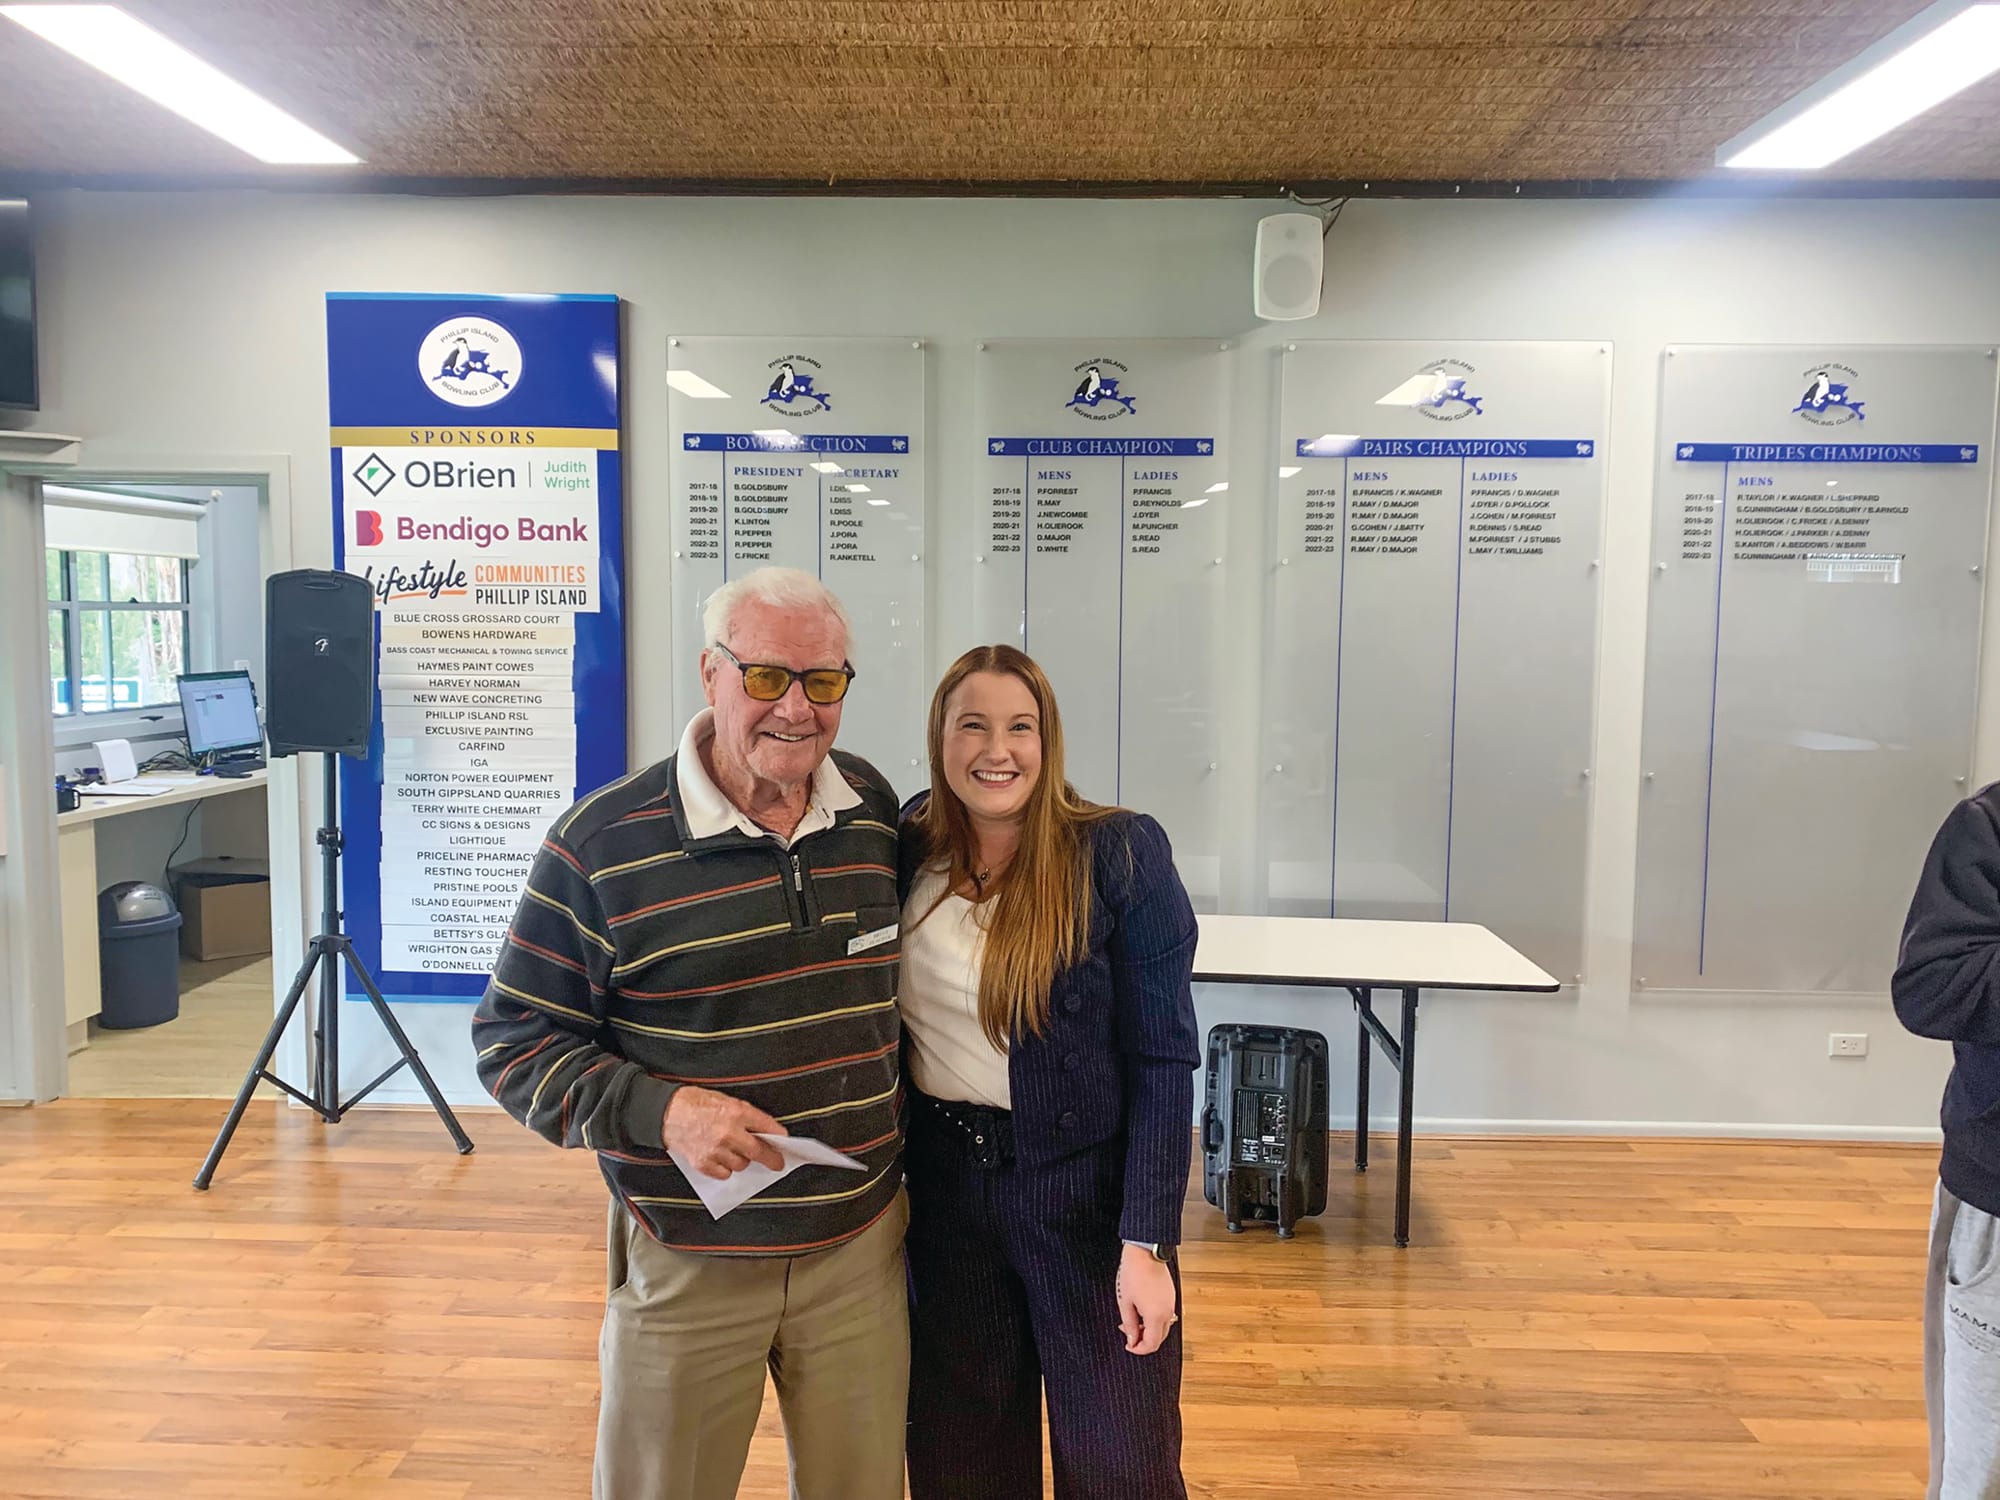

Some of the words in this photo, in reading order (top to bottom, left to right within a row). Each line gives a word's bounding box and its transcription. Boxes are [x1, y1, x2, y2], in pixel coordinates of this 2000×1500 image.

[440, 328, 469, 343] PHILLIP
[471, 328, 500, 343] ISLAND
[442, 381, 478, 396] BOWLING
[480, 382, 500, 395] CLUB
[410, 430, 535, 444] SPONSORS
[1027, 440, 1072, 454] CLUB
[1076, 440, 1174, 454] CHAMPION
[1363, 442, 1412, 455] PAIRS
[1418, 442, 1527, 456] CHAMPIONS
[1732, 446, 1804, 460] TRIPLES
[1810, 446, 1922, 462] CHAMPIONS
[544, 462, 587, 473] Judith
[734, 466, 803, 476] PRESIDENT
[404, 461, 516, 488] OBrien
[1038, 470, 1071, 480] MENS
[1134, 471, 1178, 480] LADIES
[1353, 472, 1388, 480] MENS
[1472, 472, 1518, 482] LADIES
[544, 476, 590, 491] Wright
[1738, 476, 1773, 486] MENS
[397, 516, 509, 548] Bendigo
[518, 518, 588, 542] Bank
[474, 565, 586, 583] COMMUNITIES
[476, 589, 530, 605] PHILLIP
[536, 590, 587, 606] ISLAND
[394, 614, 421, 623] BLUE
[423, 614, 460, 623] CROSS
[462, 614, 522, 624] GROSSARD
[524, 615, 560, 624] COURT
[422, 630, 470, 639] BOWENS
[473, 630, 536, 640] HARDWARE
[417, 662, 460, 670] HAYMES
[462, 662, 493, 671] PAINT
[495, 663, 534, 672] COWES
[429, 679, 471, 688] HARVEY
[474, 679, 520, 688] NORMAN
[413, 694, 436, 703] NEW
[440, 695, 469, 703] WAVE
[472, 695, 543, 704] CONCRETING
[425, 710, 465, 720] PHILLIP
[468, 711, 506, 720] ISLAND
[508, 712, 528, 721] RSL
[425, 726, 482, 736] EXCLUSIVE
[484, 727, 534, 736] PAINTING
[458, 742, 505, 751] CARFIND
[470, 758, 488, 767] IGA
[405, 773, 449, 782] NORTON
[452, 774, 490, 783] POWER
[492, 774, 554, 783] EQUIPMENT
[397, 788, 436, 798] SOUTH
[438, 788, 501, 798] GIPPSLAND
[504, 790, 561, 799] QUARRIES
[411, 804, 444, 814] TERRY
[446, 805, 480, 814] WHITE
[482, 806, 542, 815] CHEMMART
[422, 820, 437, 829] CC
[439, 820, 471, 830] SIGNS
[473, 822, 481, 830] &
[484, 821, 531, 830] DESIGNS
[449, 836, 506, 845] LIGHTIQUE
[417, 851, 474, 861] PRICELINE
[477, 853, 537, 862] PHARMACY
[424, 866, 472, 877] RESTING
[475, 868, 528, 877] TOUCHER
[433, 882, 480, 892] PRISTINE
[482, 884, 518, 893] POOLS
[411, 898, 450, 907] ISLAND
[452, 898, 512, 908] EQUIPMENT
[430, 913, 480, 923] COASTAL
[433, 929, 484, 938] BETTSY'S
[408, 944, 467, 954] WRIGHTON
[470, 946, 492, 954] GAS
[422, 960, 484, 970] O'DONNELL
